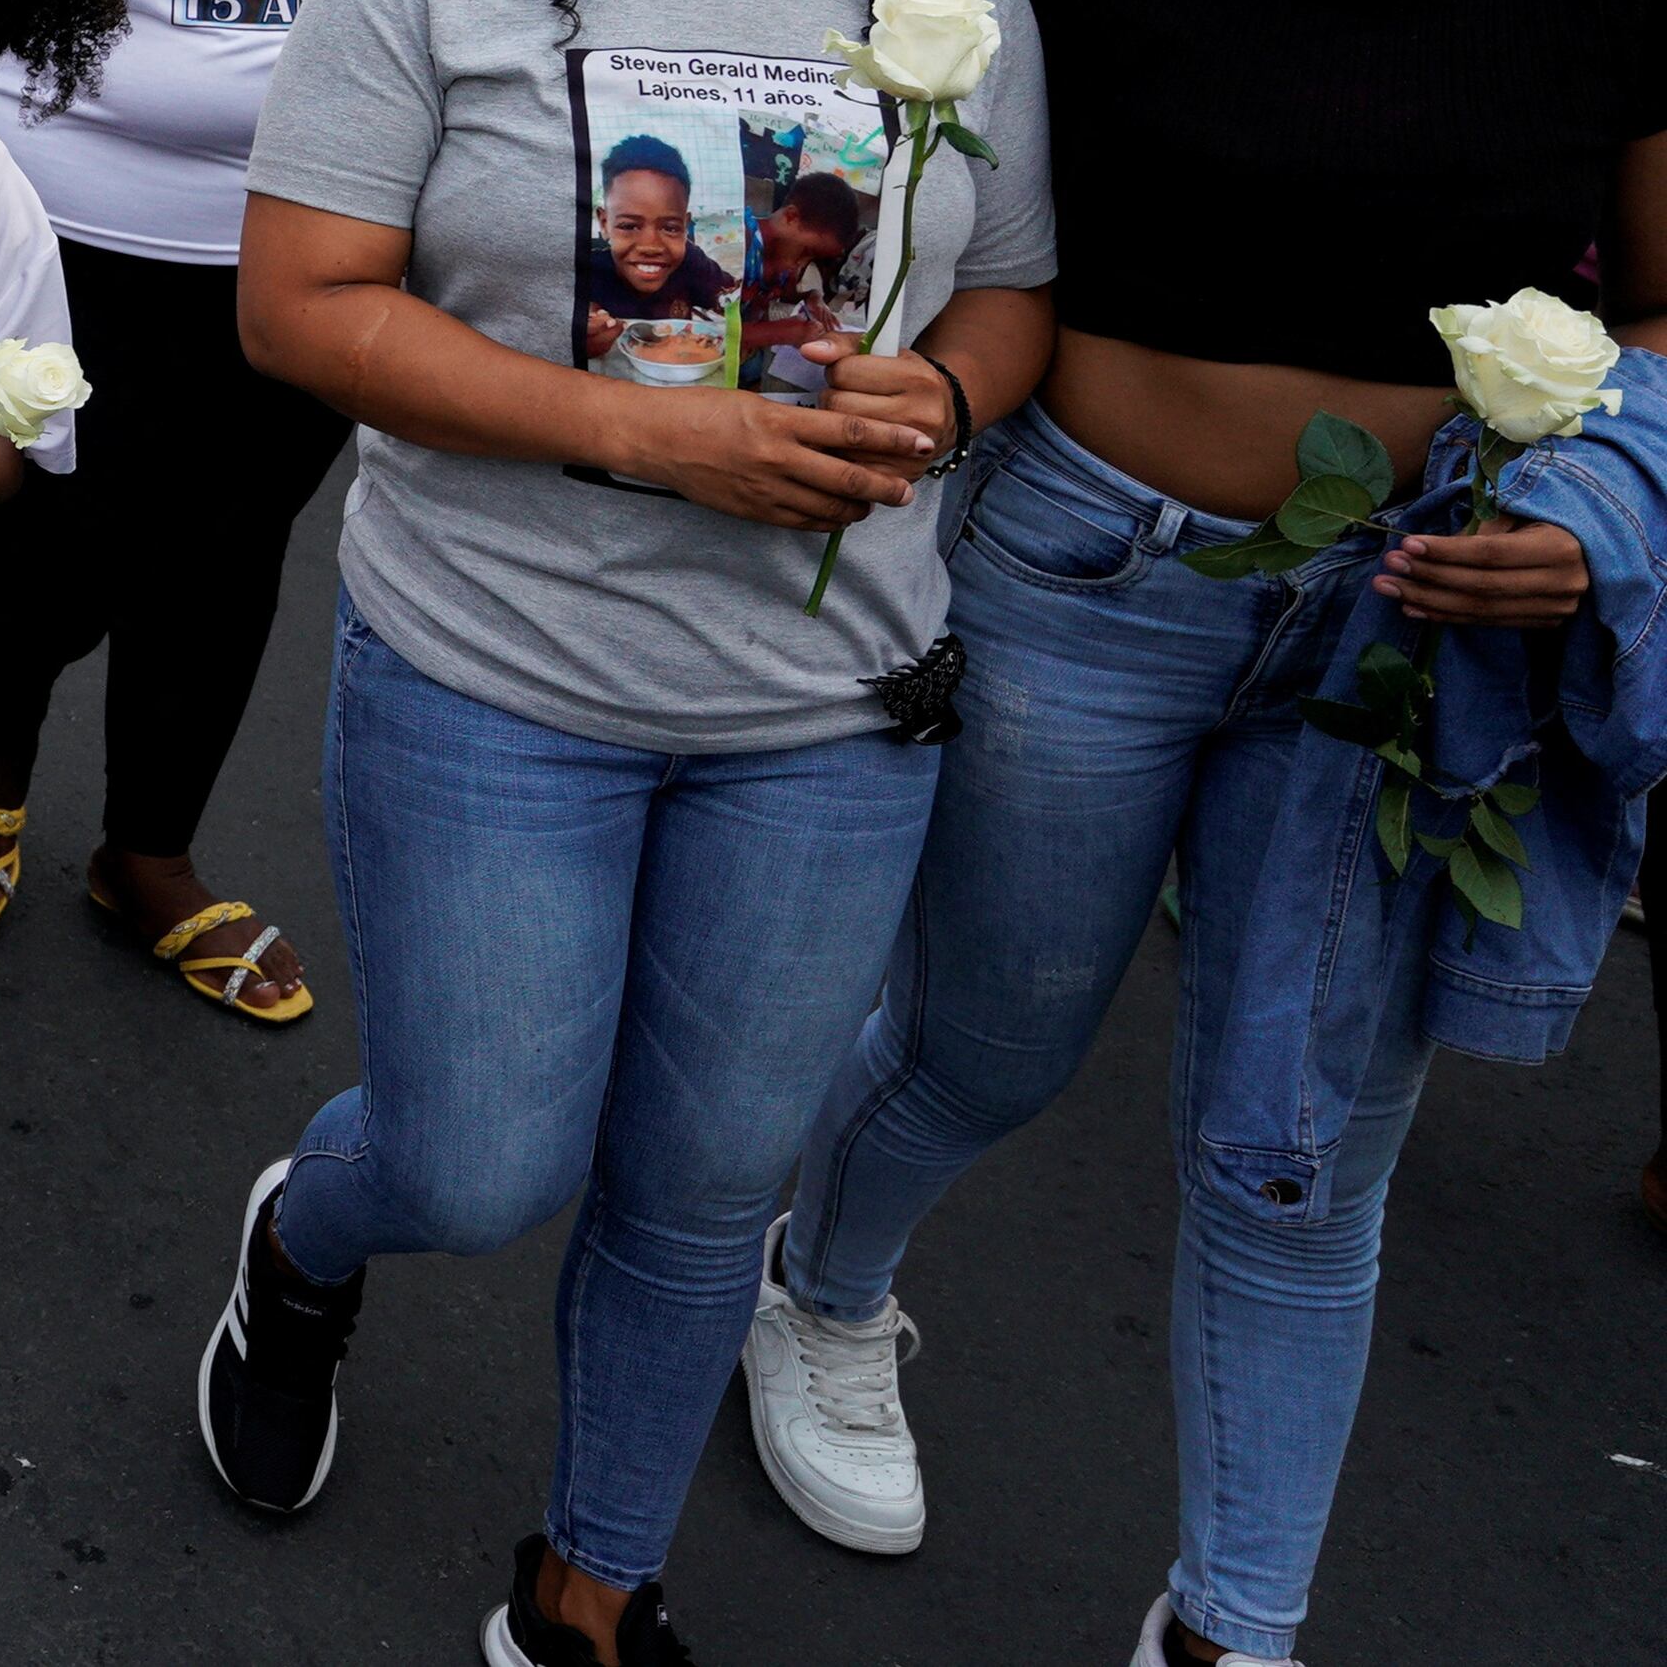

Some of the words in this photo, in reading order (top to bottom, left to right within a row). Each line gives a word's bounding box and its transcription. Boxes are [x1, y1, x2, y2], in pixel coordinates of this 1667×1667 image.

[610, 55, 681, 74] Steven
[688, 58, 758, 79] Gerald
[638, 79, 727, 104] Lajones,
[733, 88, 755, 103] 11
[764, 89, 823, 107] años.
